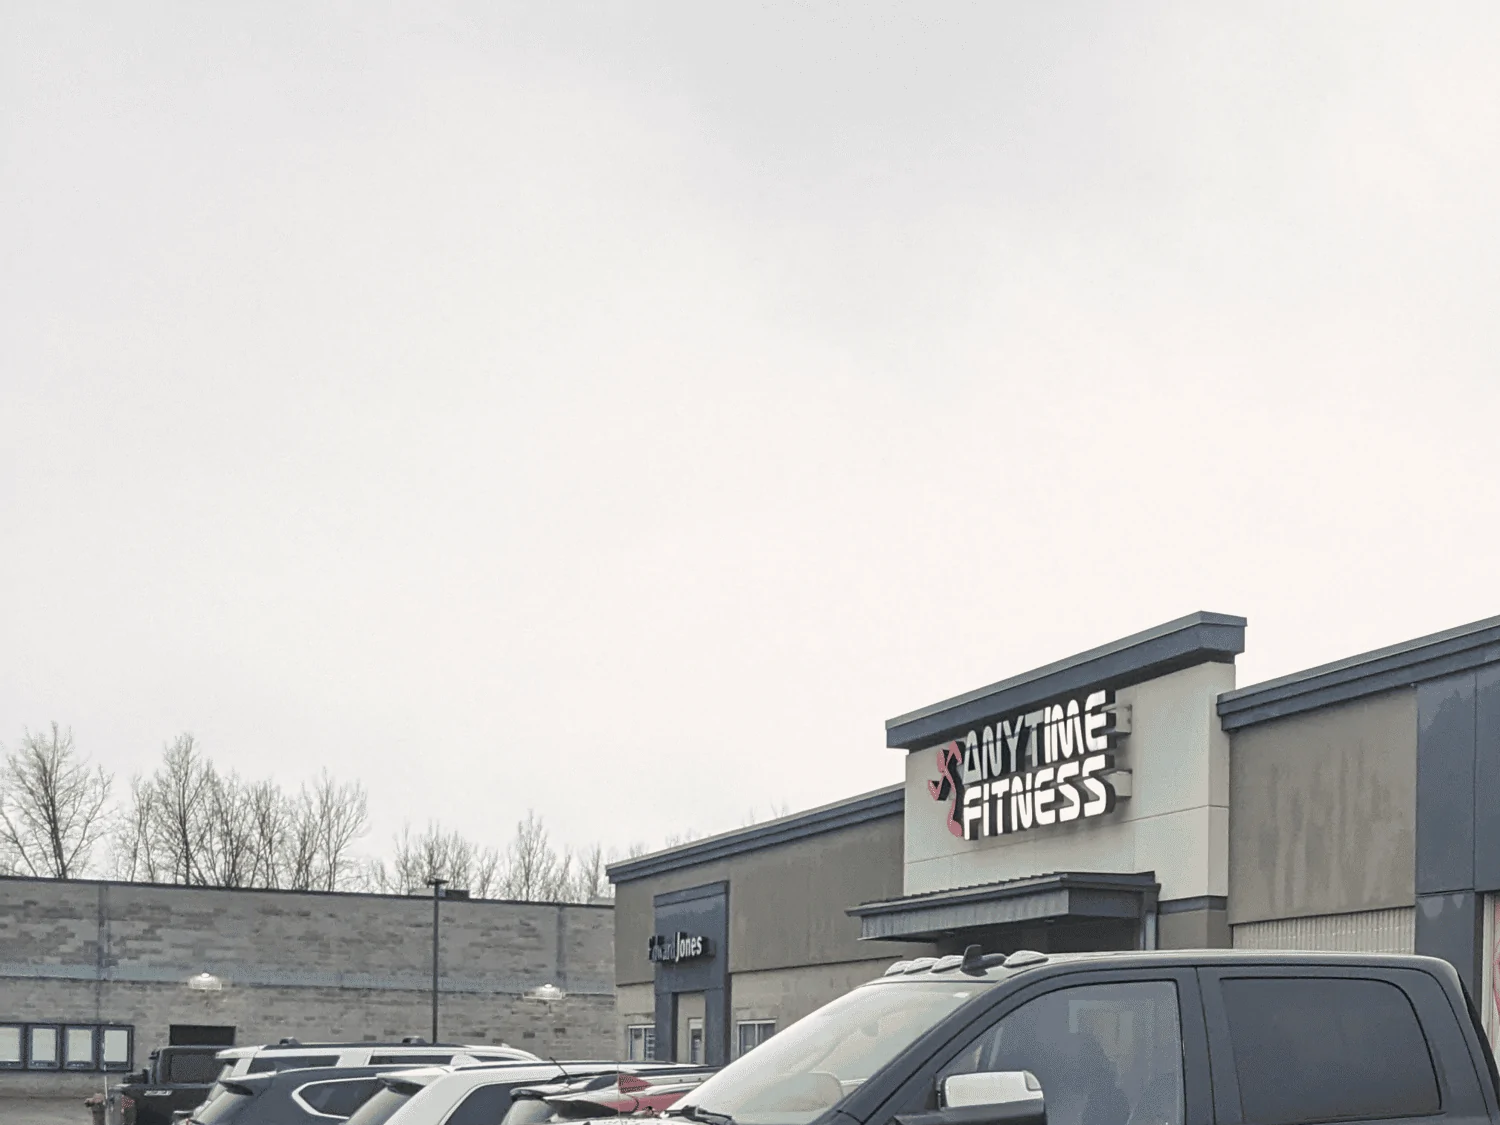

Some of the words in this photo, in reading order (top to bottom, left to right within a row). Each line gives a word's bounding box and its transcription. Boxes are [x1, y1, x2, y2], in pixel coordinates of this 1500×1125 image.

[962, 689, 1108, 785] ANYTIME
[963, 754, 1107, 841] FITNESS
[675, 931, 703, 963] Jones
